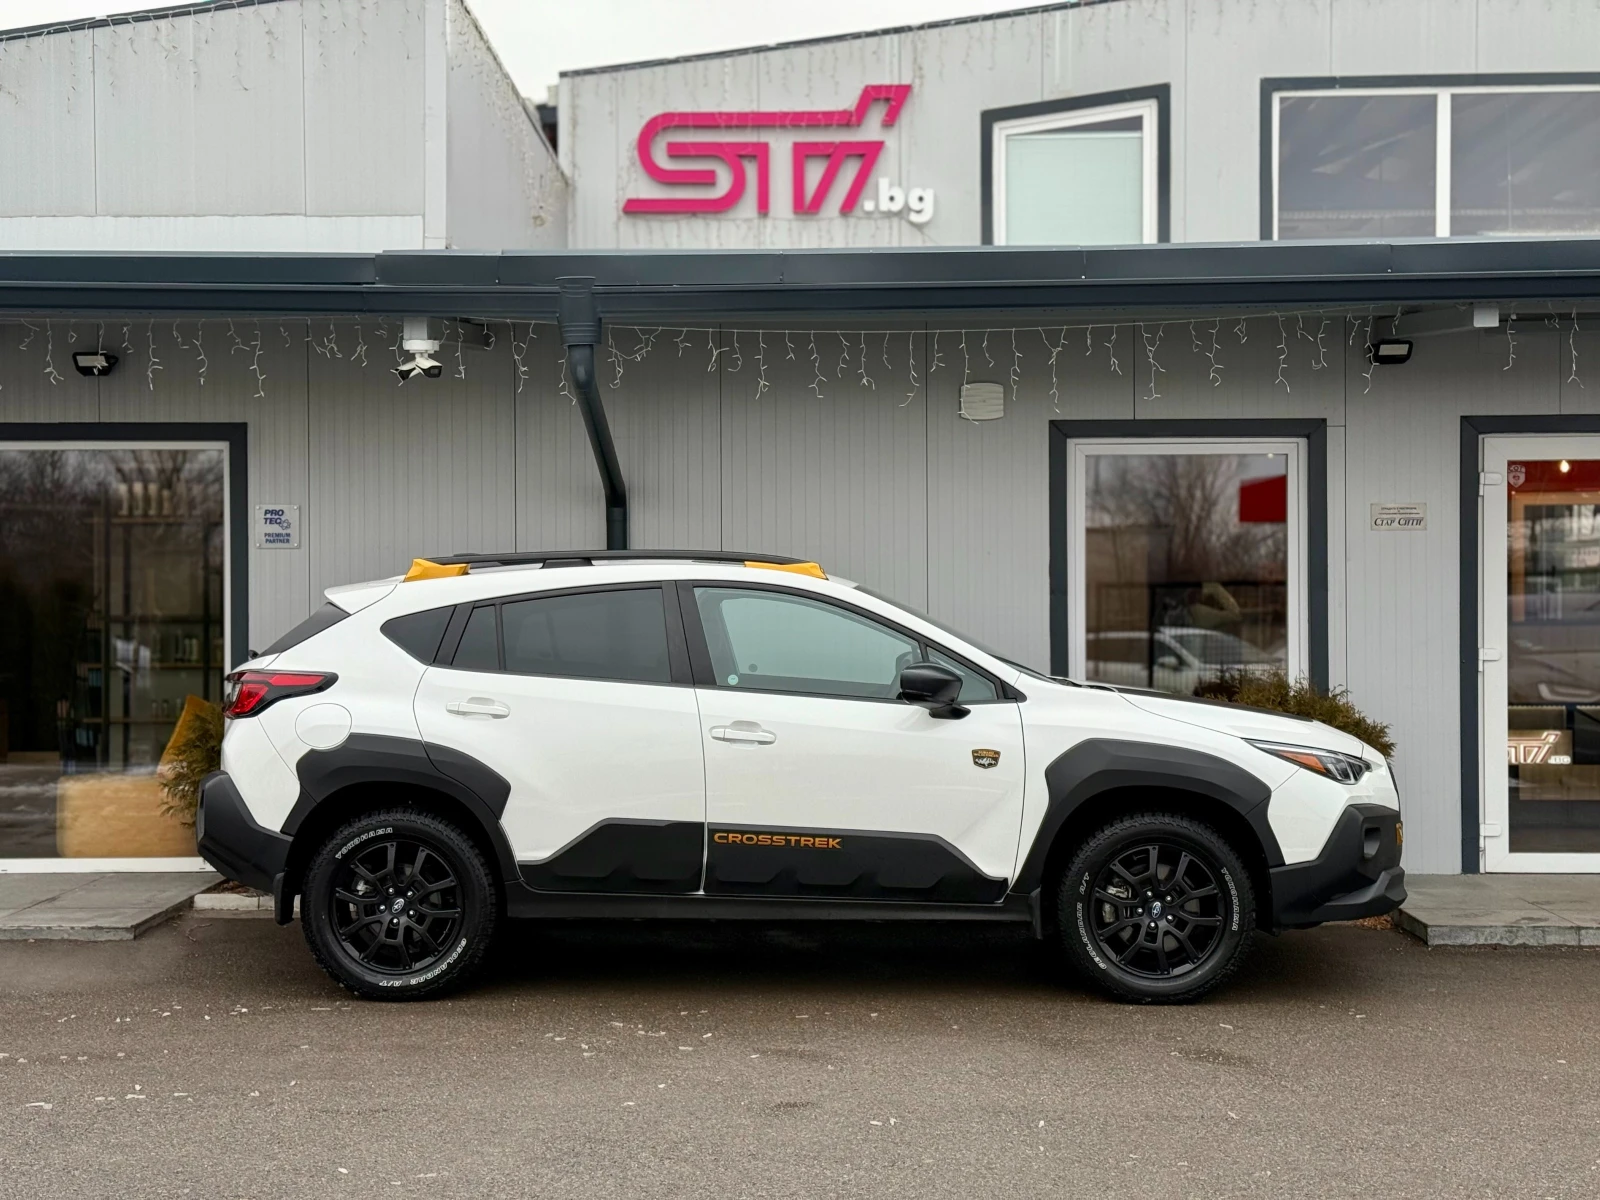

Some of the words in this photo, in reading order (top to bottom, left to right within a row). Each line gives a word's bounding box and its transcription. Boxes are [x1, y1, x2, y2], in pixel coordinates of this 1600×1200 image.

[264, 509, 284, 517] PRO
[335, 827, 393, 859] YOKOHAMA
[713, 832, 842, 849] CROSSTREK
[409, 938, 467, 985] GEOLANDAR
